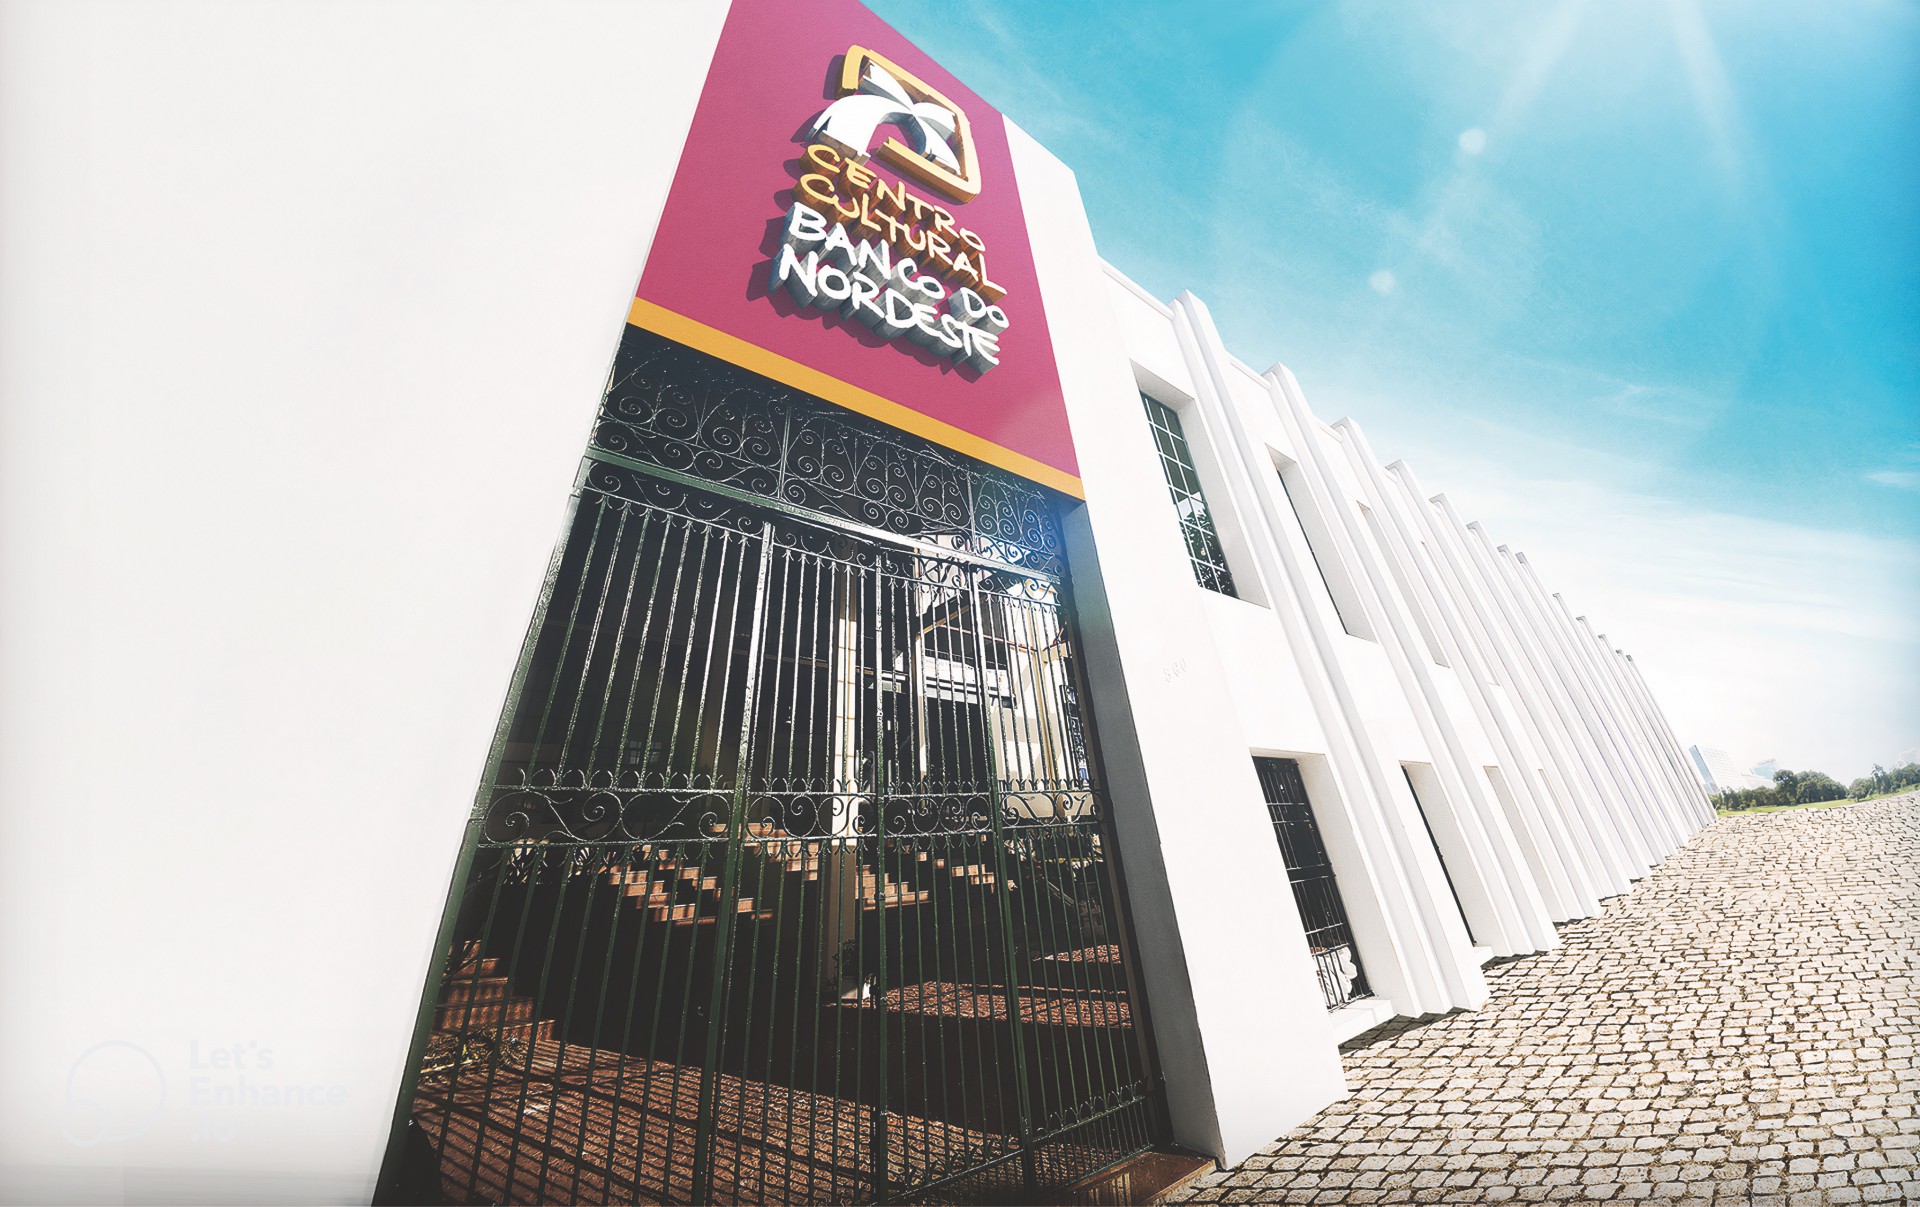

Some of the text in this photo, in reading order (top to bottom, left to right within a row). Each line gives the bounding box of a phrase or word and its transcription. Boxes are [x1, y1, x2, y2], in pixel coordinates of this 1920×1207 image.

[788, 202, 946, 300] BANCO
[800, 174, 1008, 297] CULTURAL
[808, 144, 986, 252] CENTRO
[779, 244, 1001, 366] NORDESTE
